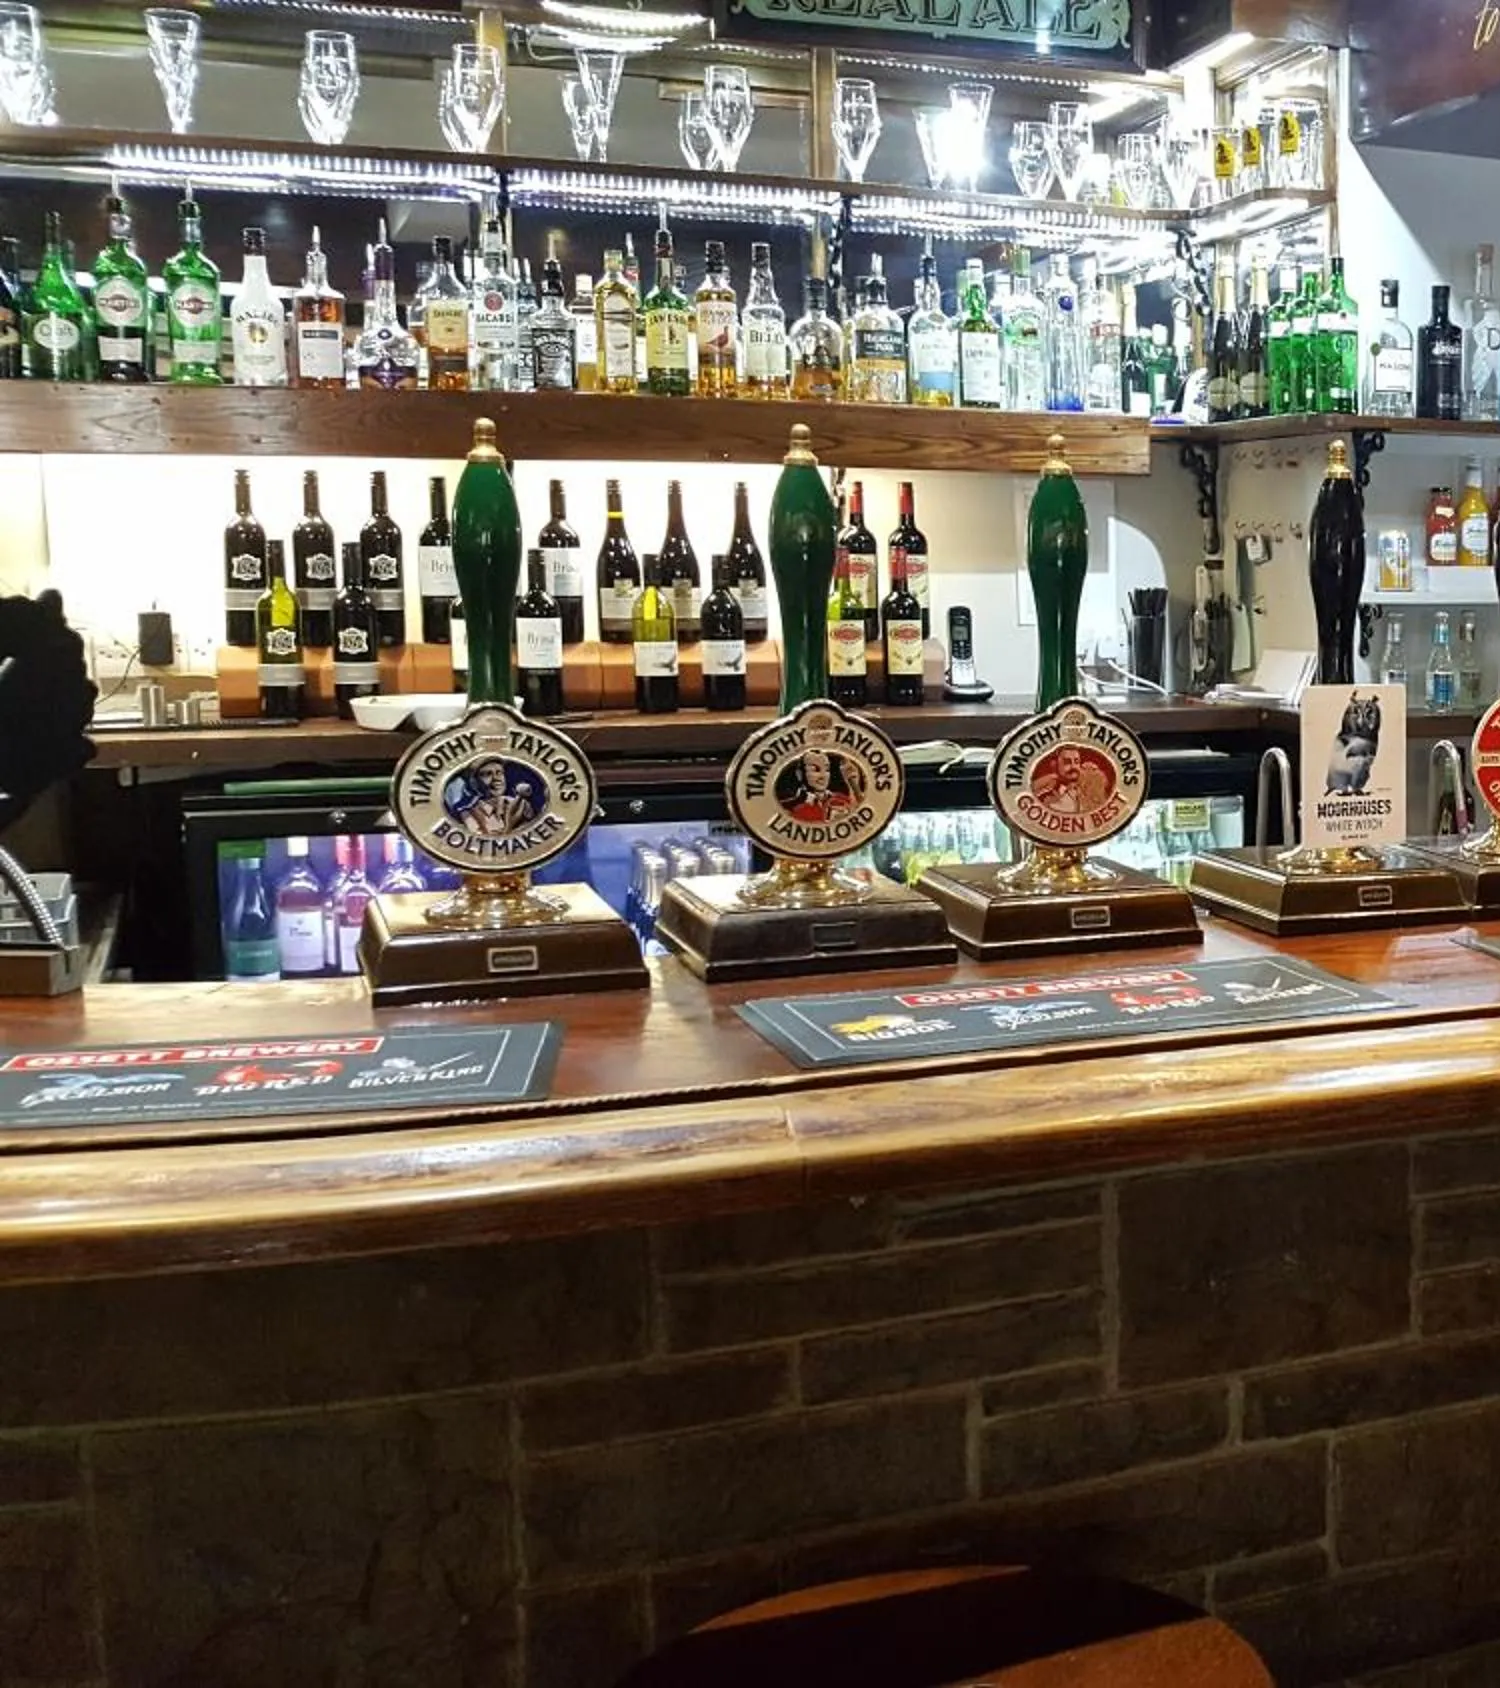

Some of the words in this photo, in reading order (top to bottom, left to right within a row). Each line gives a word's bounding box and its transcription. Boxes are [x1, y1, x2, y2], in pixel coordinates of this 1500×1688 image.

[969, 0, 1101, 40] ALE
[409, 730, 478, 809] TIMOTHY
[508, 730, 580, 803] TAYLOR'S
[746, 727, 808, 801] TIMOTHY
[832, 725, 892, 793] TAYLOR'S
[1005, 722, 1062, 791] TIMOTHY
[1086, 721, 1138, 788] TAYLOR'S
[768, 806, 875, 845] LANDLORD
[1017, 794, 1087, 834] GOLDEN
[1090, 790, 1128, 829] BEST
[1317, 798, 1393, 820] MOORHOUSES
[433, 813, 565, 858] BOLTMAKER
[28, 1050, 166, 1068] OSSETT
[183, 1039, 368, 1061] BREWERY
